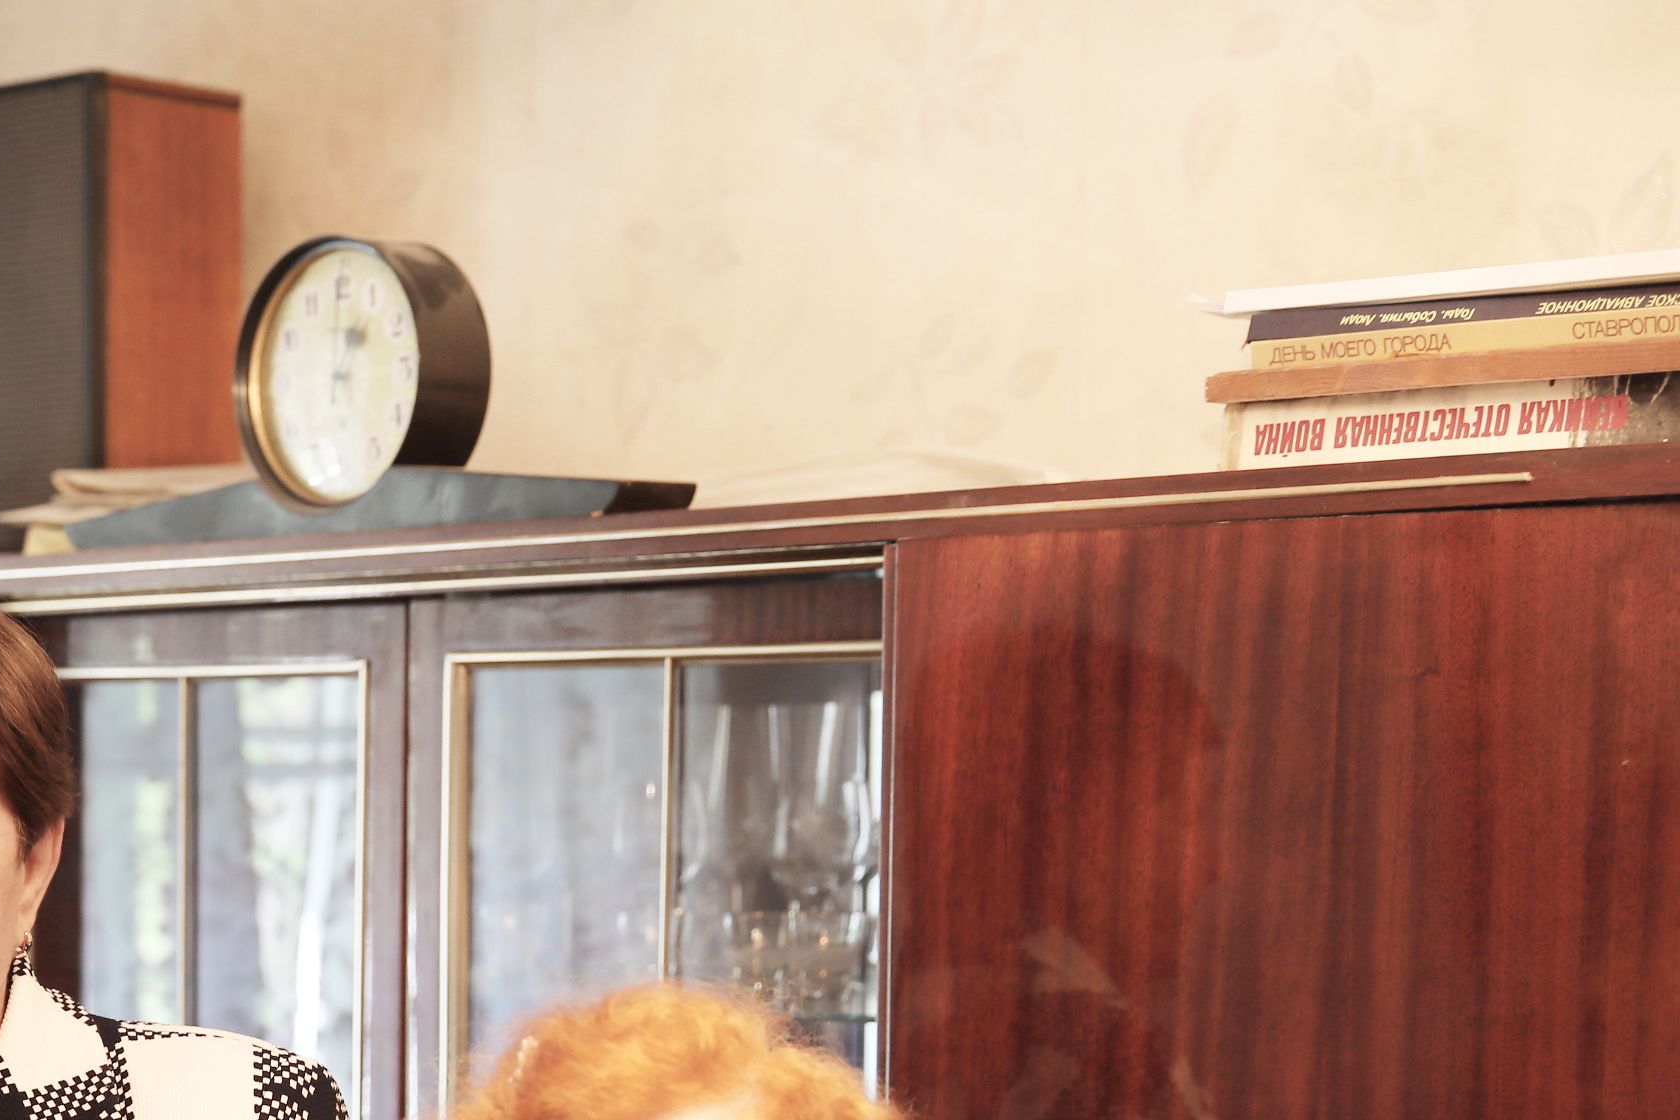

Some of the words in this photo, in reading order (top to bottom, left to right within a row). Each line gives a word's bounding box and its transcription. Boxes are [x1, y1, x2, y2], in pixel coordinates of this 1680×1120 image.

[1379, 310, 1437, 325] События.
[1441, 307, 1476, 321] Годы.
[1535, 295, 1646, 315] АВИАЦИОННОЕ
[1340, 313, 1377, 326] Люди
[1572, 314, 1680, 340] СТАВРОПОЛ
[1269, 345, 1316, 366] ДЕНЬ
[1321, 338, 1377, 360] МОЕГО
[1383, 333, 1452, 355] ГОРОДА
[1333, 403, 1512, 449] ОТЕЧЕСТВЕННАЯ
[1517, 393, 1630, 436] ВЕЛИКАЯ
[1253, 417, 1327, 457] ВОЙНА
